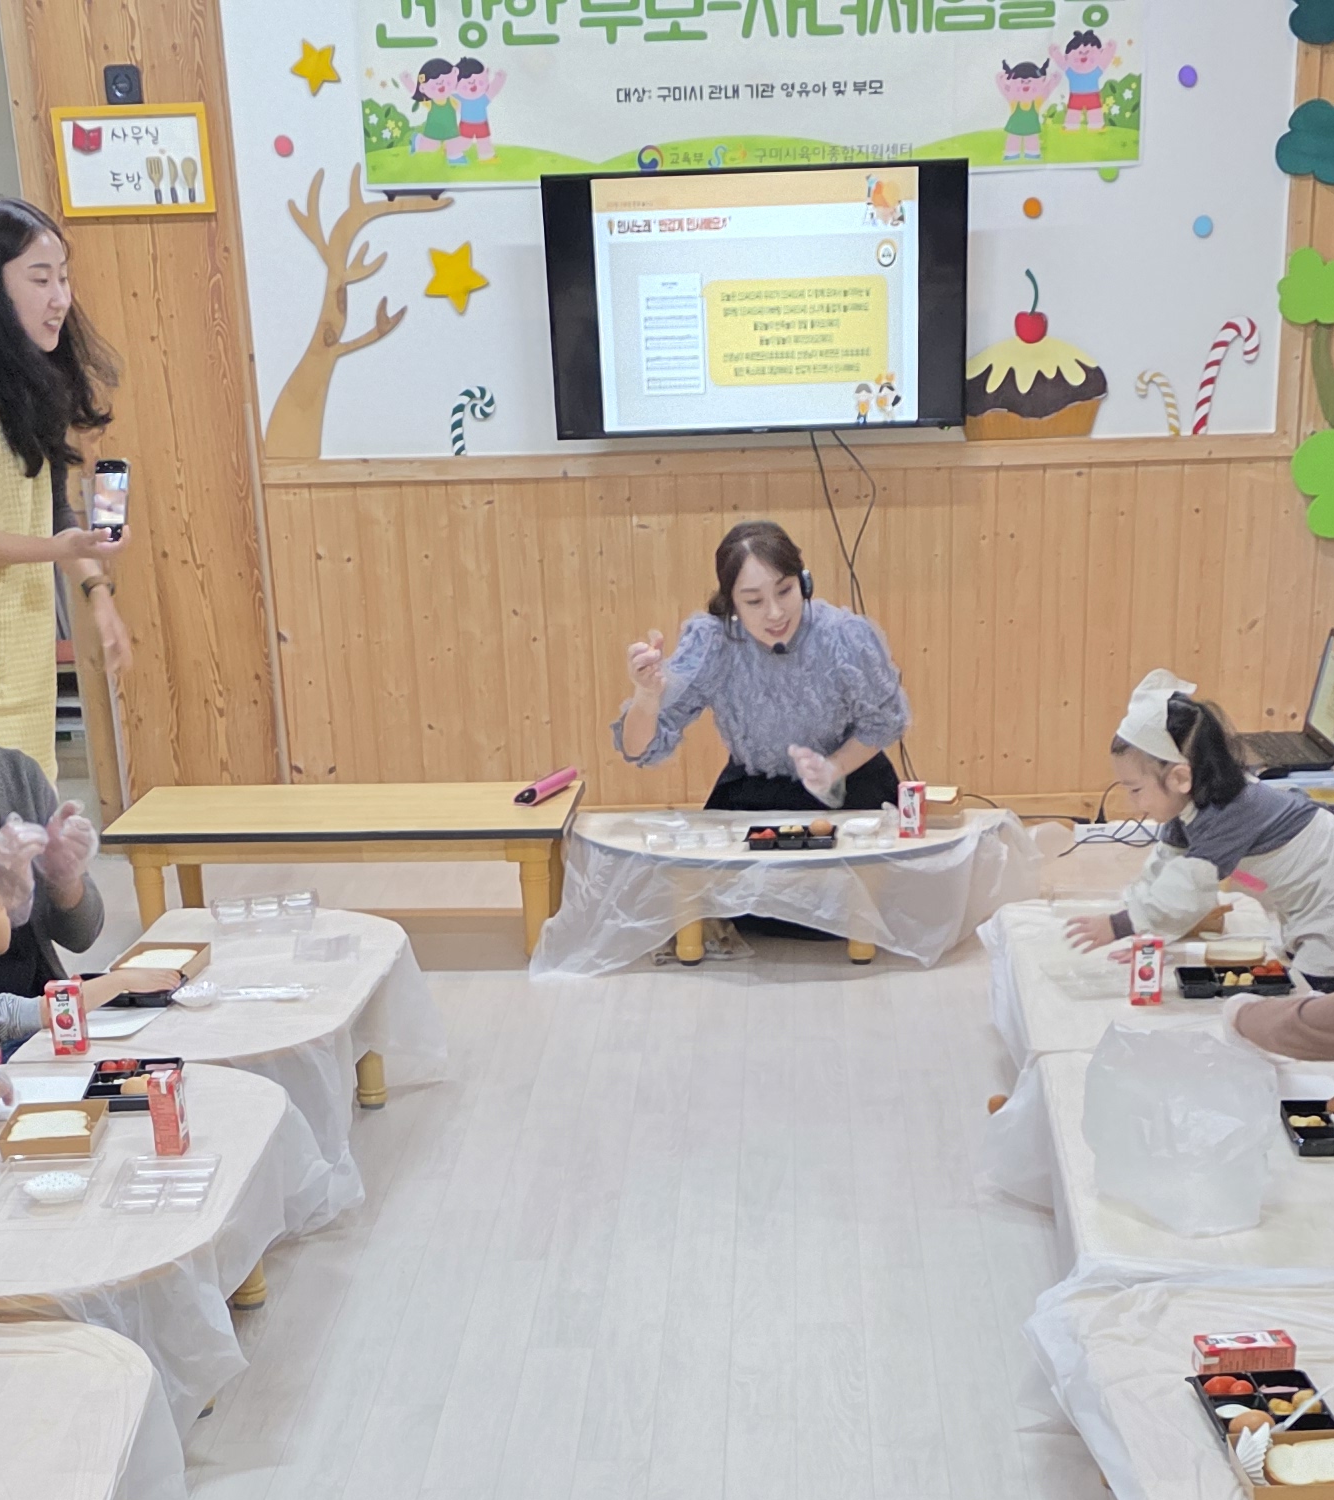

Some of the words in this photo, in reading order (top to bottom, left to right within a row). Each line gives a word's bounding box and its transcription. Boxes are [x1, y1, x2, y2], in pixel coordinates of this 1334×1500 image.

[616, 86, 652, 103] 대상:
[657, 85, 704, 102] 구미시
[708, 84, 740, 100] 관내
[744, 82, 775, 99] 기관
[780, 81, 827, 98] 영유아
[832, 80, 847, 97] 및
[852, 79, 884, 95] 부모
[111, 125, 159, 145] 사무실
